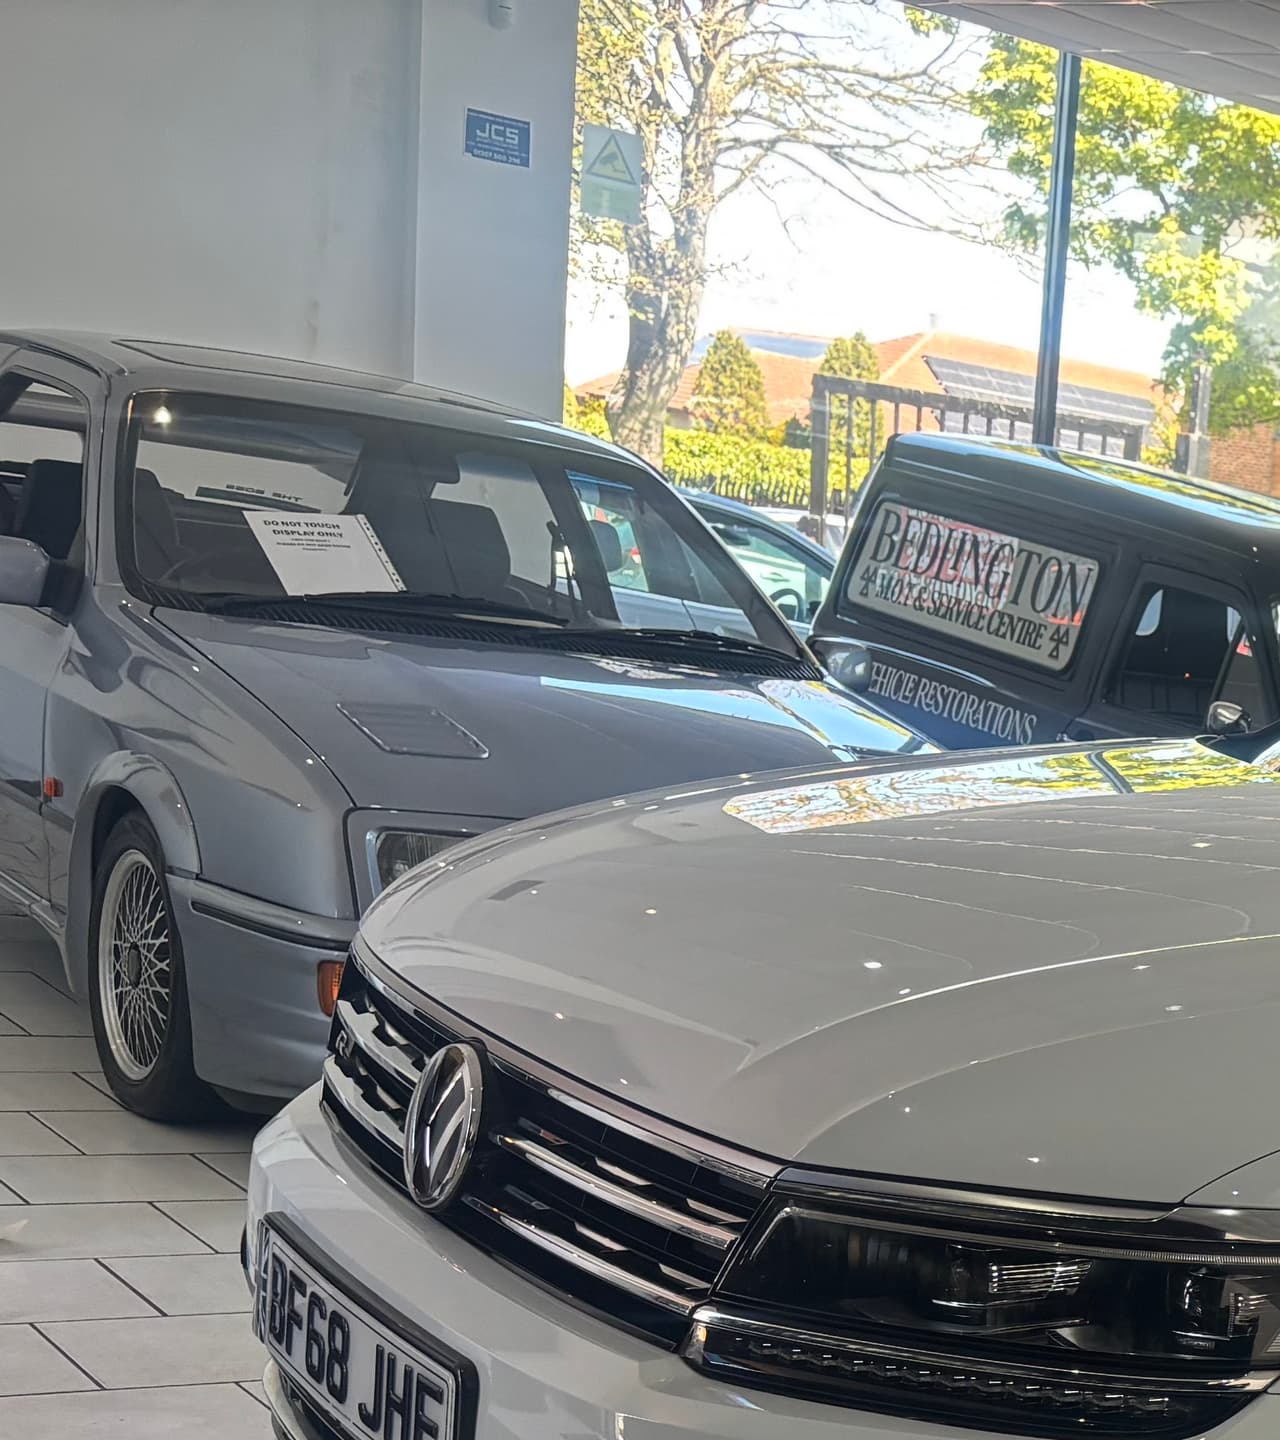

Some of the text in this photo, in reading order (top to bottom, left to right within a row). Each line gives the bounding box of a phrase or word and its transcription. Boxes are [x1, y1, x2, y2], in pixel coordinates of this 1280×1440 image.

[476, 122, 519, 145] JCS
[272, 529, 343, 538] DISPLAY ONLY
[304, 521, 341, 530] TOUCH
[870, 509, 1093, 623] BEDLINGTON
[927, 594, 988, 632] SERVICE
[986, 609, 1048, 650] CENTRE
[868, 662, 1037, 745] EHICLE RESTORATIONS
[268, 1251, 351, 1404] BF68
